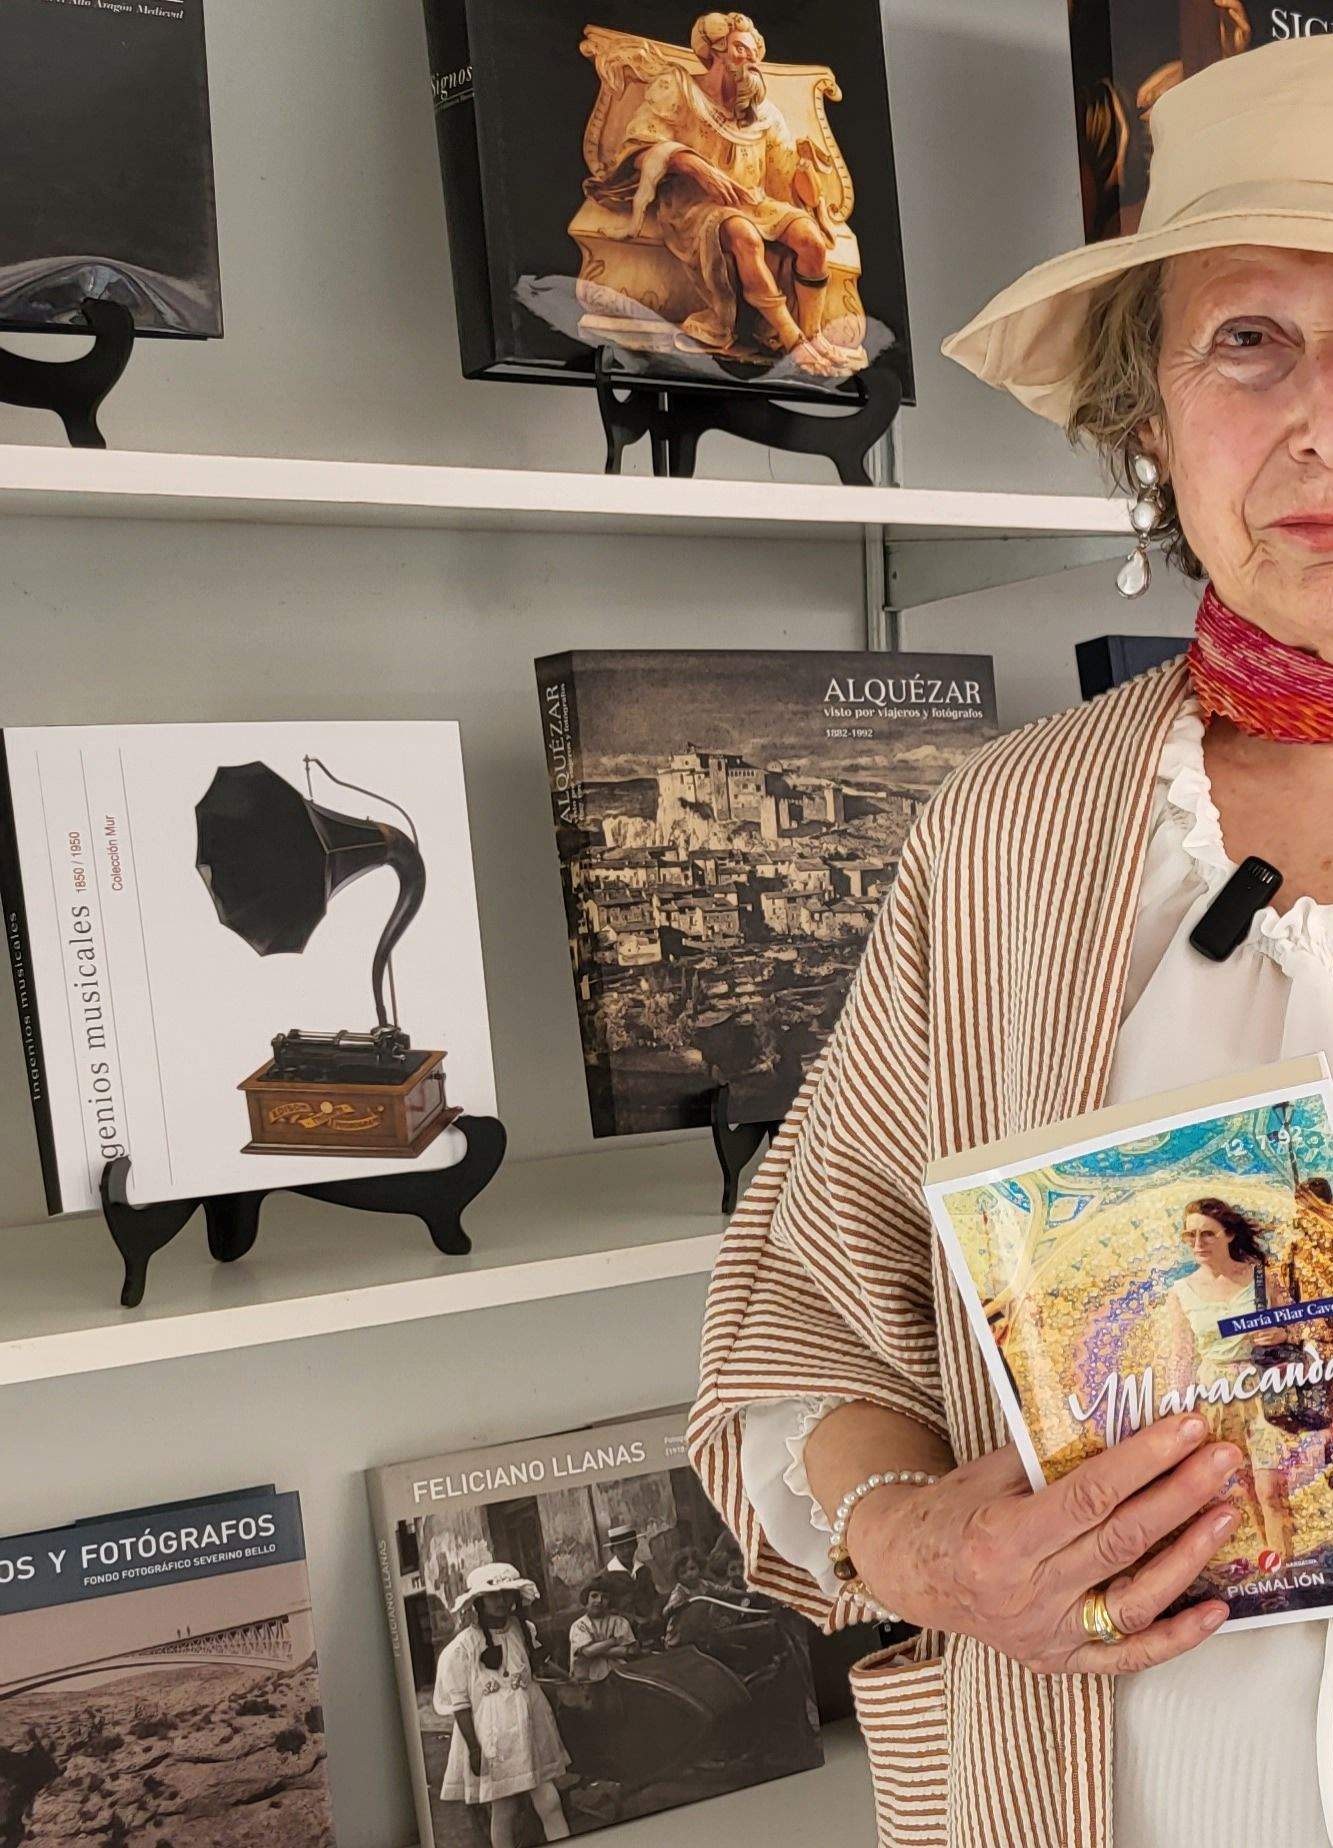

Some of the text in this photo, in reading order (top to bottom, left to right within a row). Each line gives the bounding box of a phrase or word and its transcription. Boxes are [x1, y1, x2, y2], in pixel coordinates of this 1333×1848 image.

[823, 672, 982, 707] ALQUÉZAR
[824, 706, 984, 720] visto por viajeros y fotógrafos
[825, 728, 874, 739] 1882-1992
[546, 683, 573, 824] ALQUÉZAR
[69, 831, 82, 859] 1950
[104, 815, 123, 891] Colección Mur
[75, 869, 88, 895] 1850
[8, 911, 30, 1010] musicales
[69, 904, 126, 1161] genios musicales
[1232, 1311, 1272, 1332] María
[1273, 1307, 1304, 1325] Pilar
[412, 1441, 647, 1503] FELICIANO LLANAS
[48, 1549, 66, 1574] Y
[81, 1514, 275, 1569] FOTÓGRAFOS
[83, 1543, 276, 1587] FONDO FOTOGRÁFICO SEVERINO BELLO
[379, 1539, 400, 1658] FELICIANO LLANAS
[1227, 1572, 1325, 1599] PIGMALIÓN
